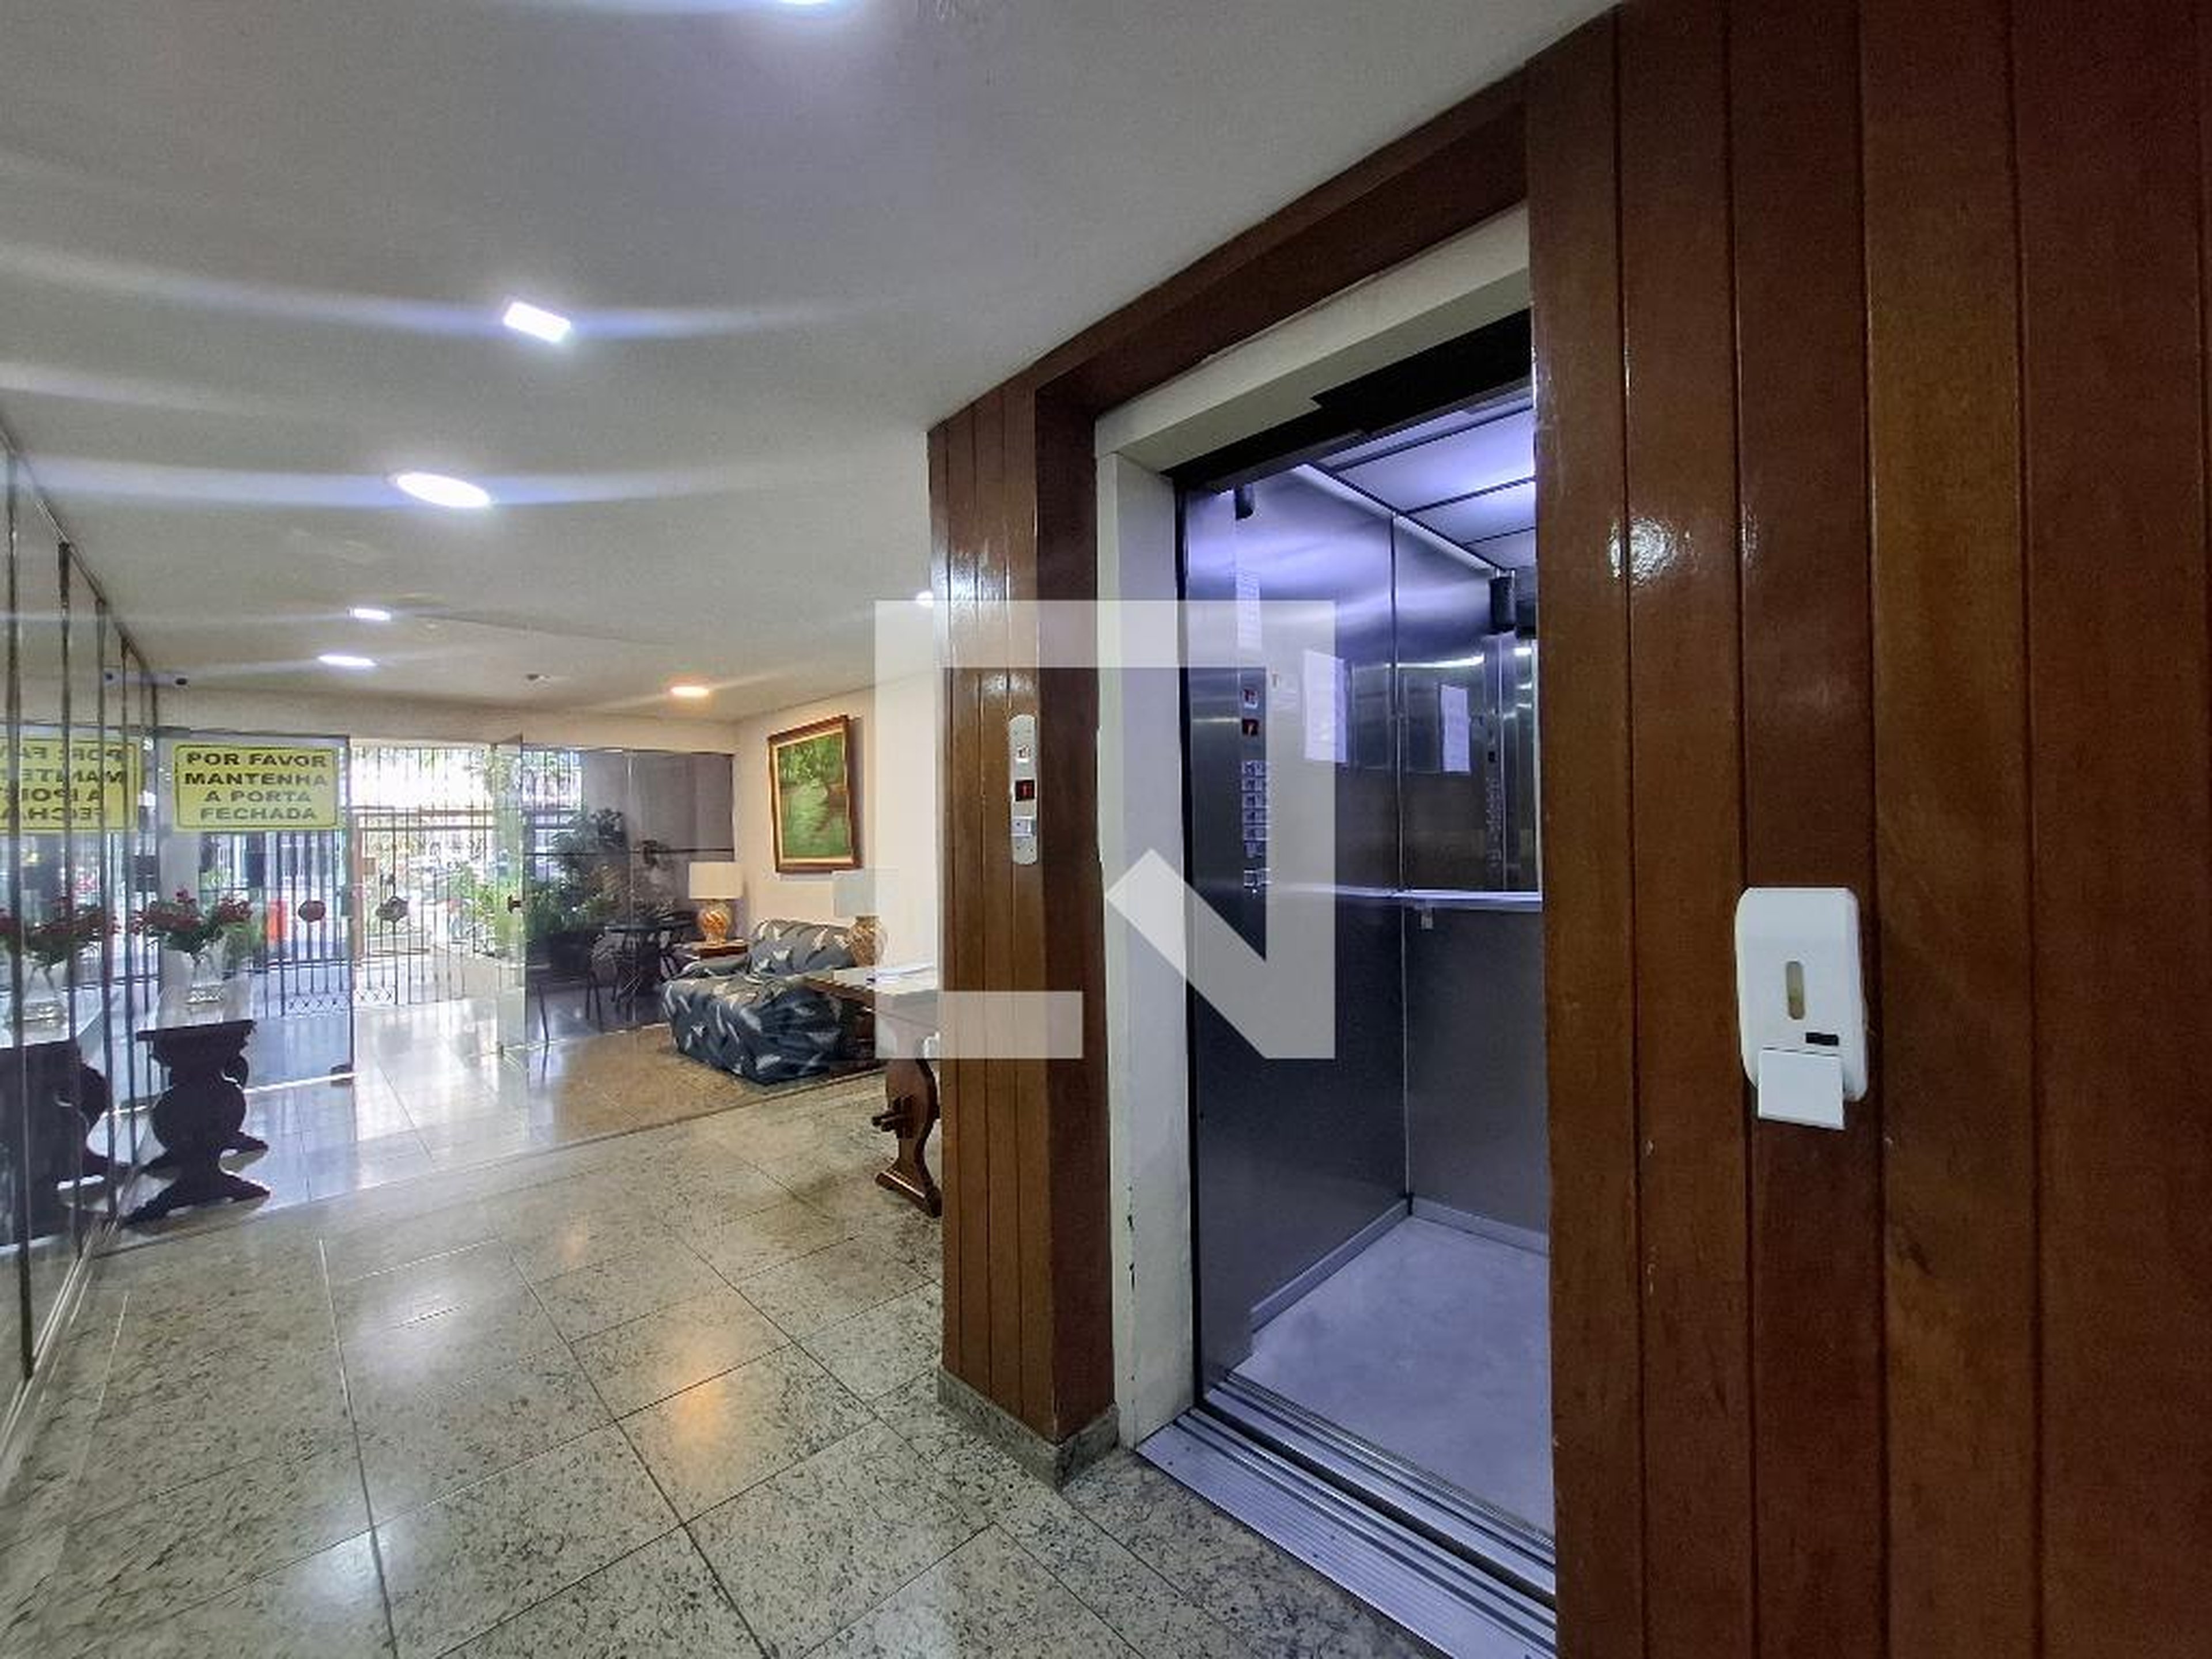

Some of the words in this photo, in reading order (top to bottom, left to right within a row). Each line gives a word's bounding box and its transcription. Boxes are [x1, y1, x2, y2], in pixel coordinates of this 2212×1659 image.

[187, 752, 240, 766] POR
[249, 753, 328, 767] FAVOR
[185, 773, 328, 787] MANTENHA
[205, 790, 221, 802] A
[231, 790, 312, 802] PORTA
[200, 808, 317, 820] FECHADA
